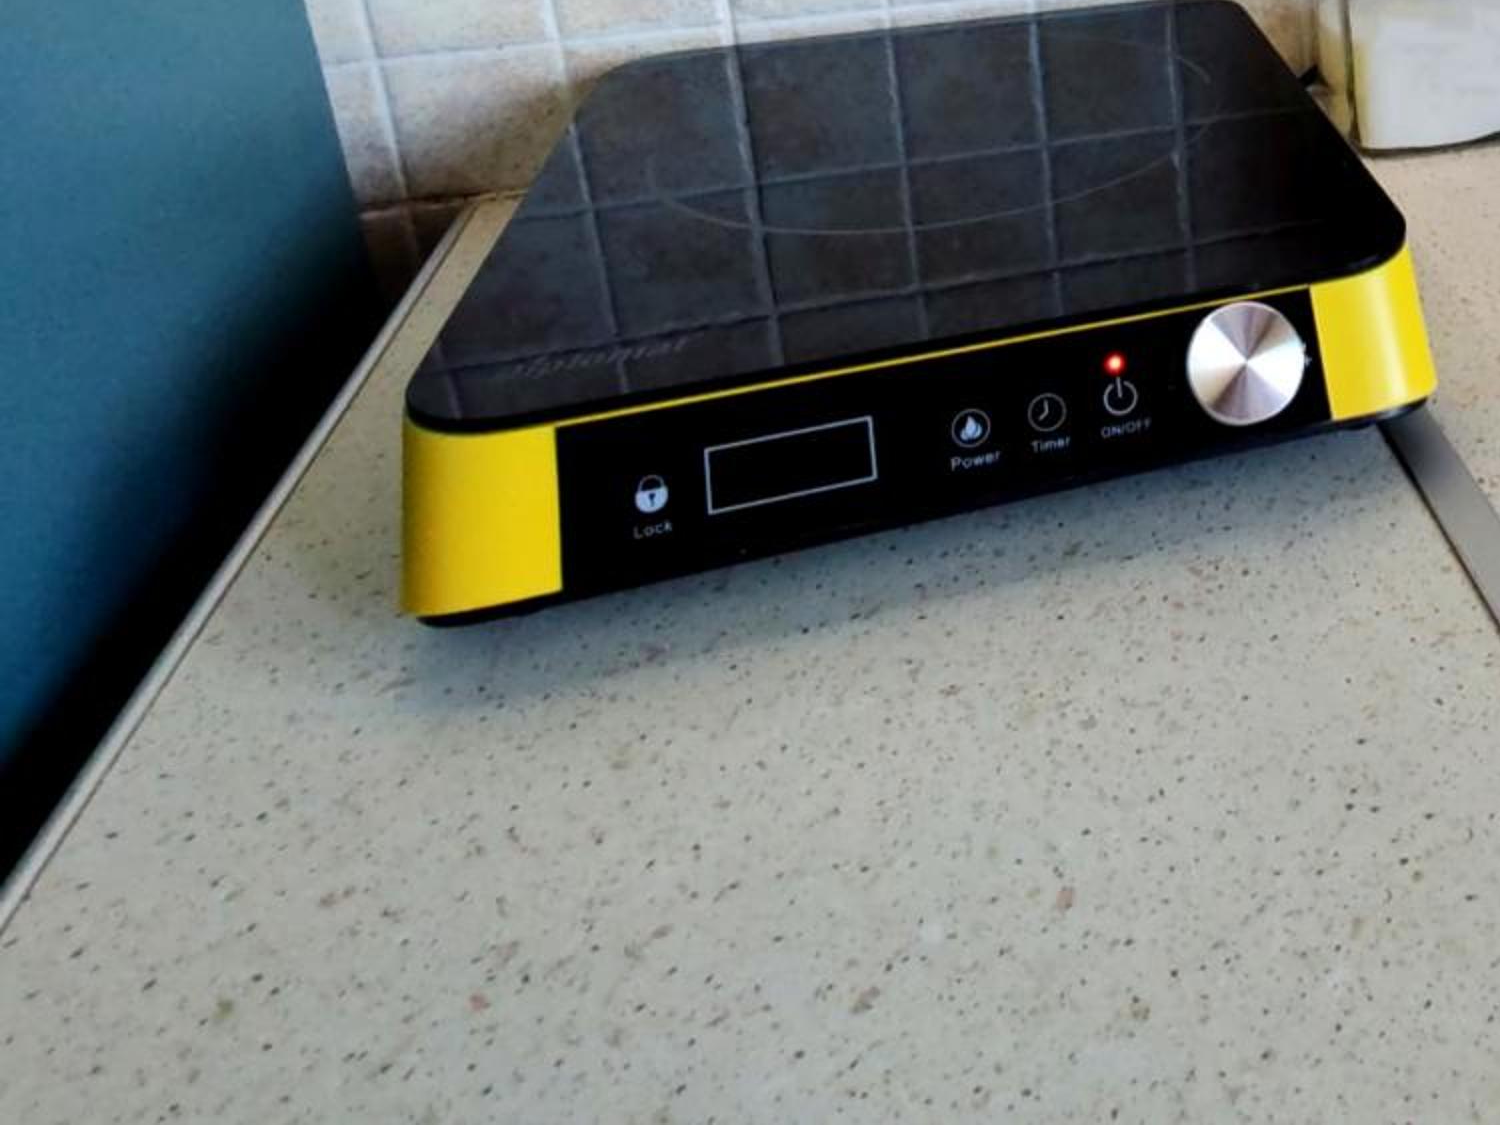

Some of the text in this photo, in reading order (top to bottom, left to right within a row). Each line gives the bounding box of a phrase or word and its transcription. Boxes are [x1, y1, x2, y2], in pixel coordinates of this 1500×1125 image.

[1101, 418, 1152, 438] ON/OFF
[1031, 436, 1071, 453] Timer
[951, 451, 1001, 471] Power
[633, 518, 672, 540] Lock
